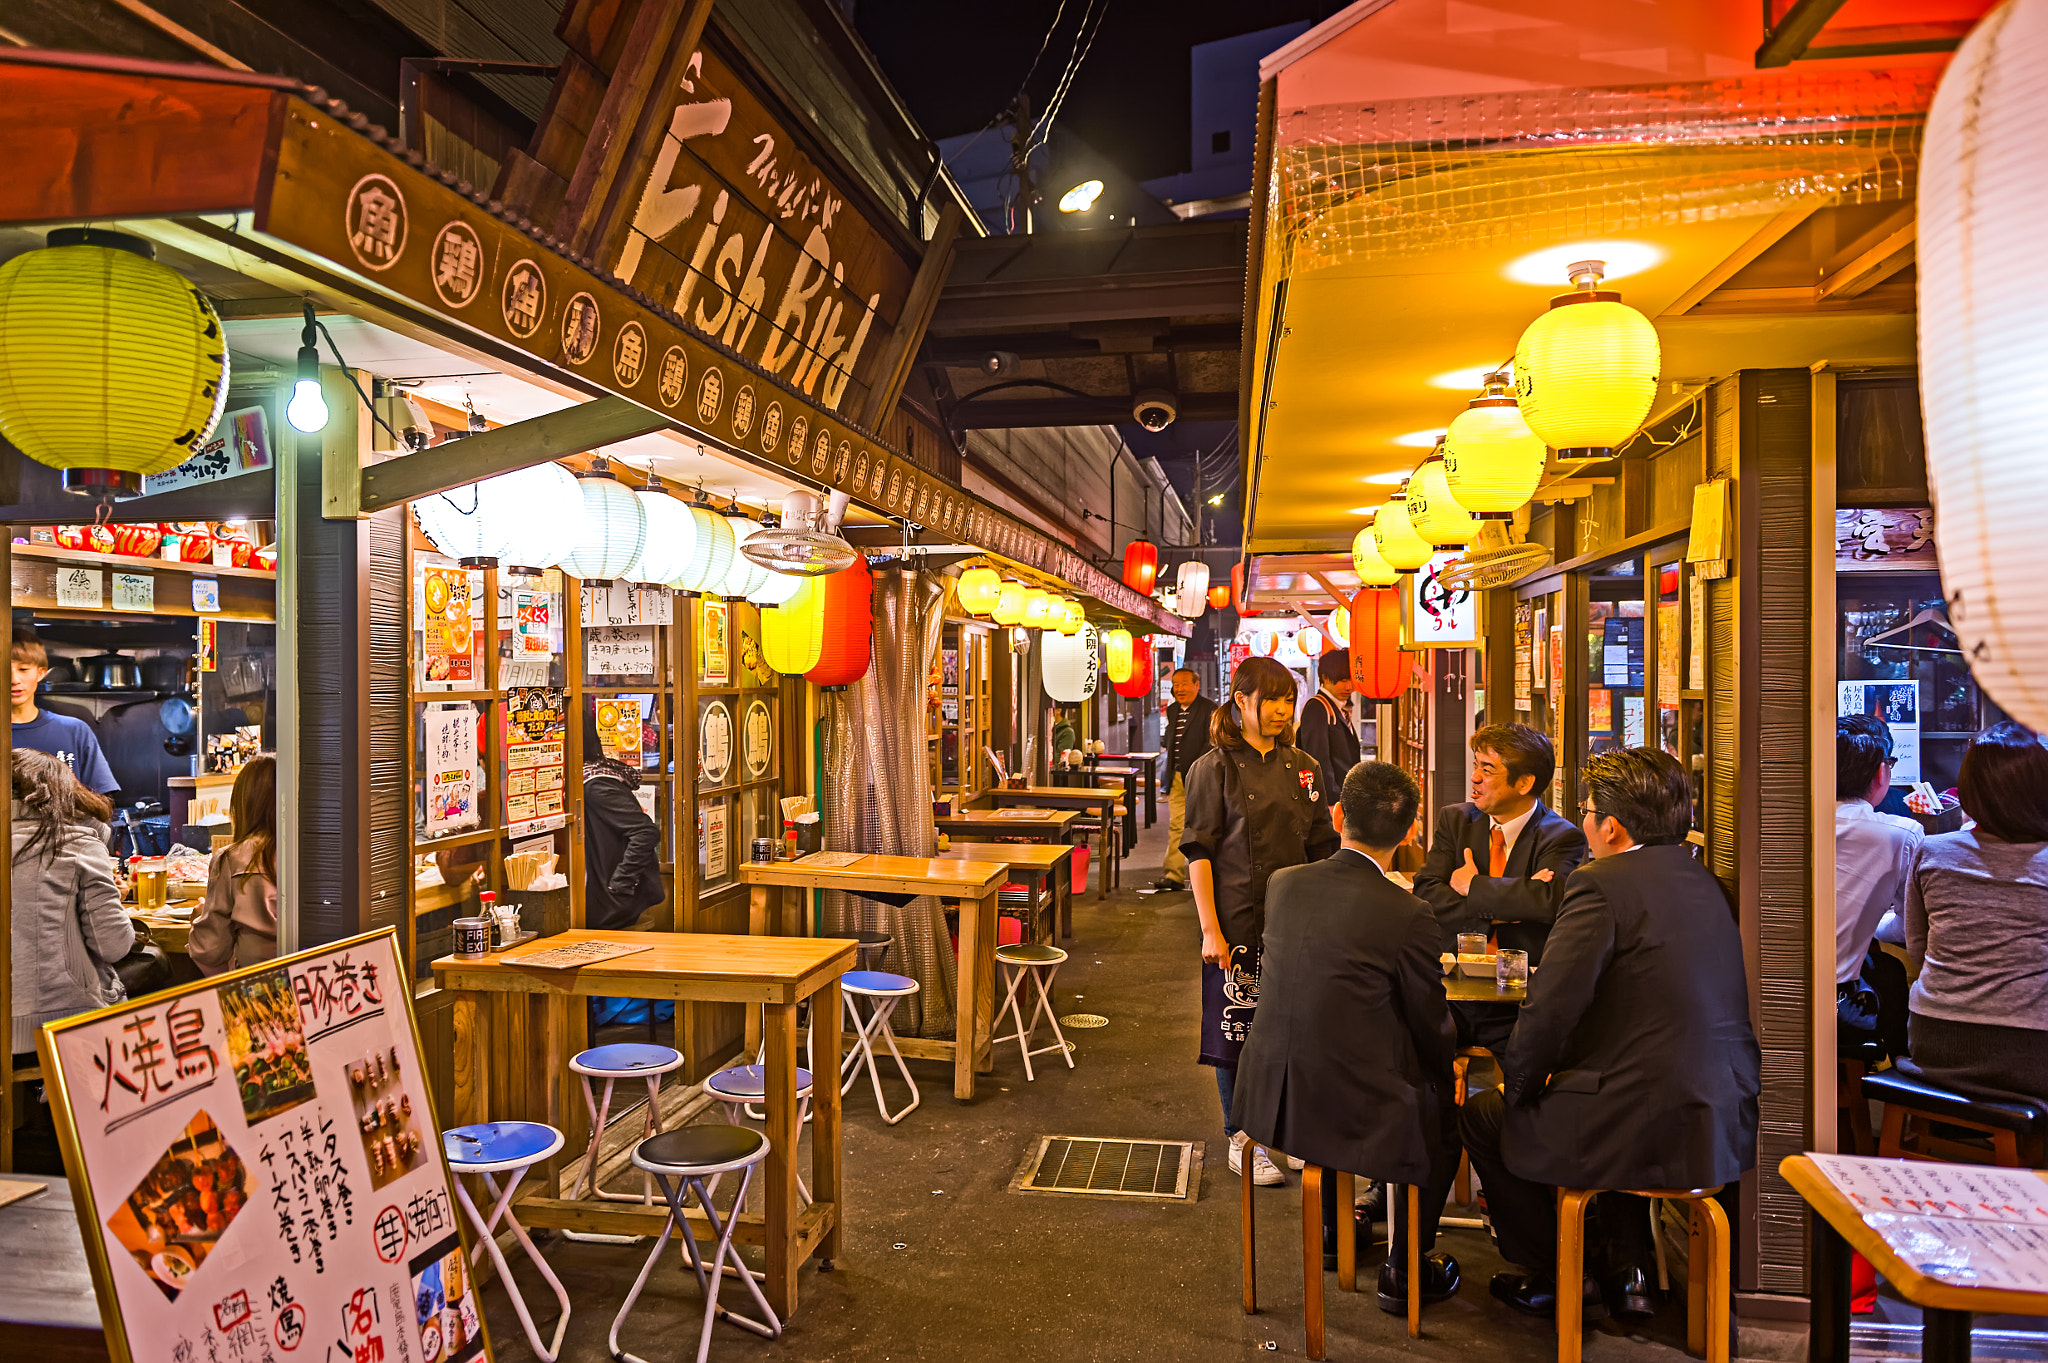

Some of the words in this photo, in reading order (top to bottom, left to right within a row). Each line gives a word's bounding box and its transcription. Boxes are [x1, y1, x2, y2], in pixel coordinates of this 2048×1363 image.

[613, 97, 774, 357] Fish
[518, 606, 548, 625] とくとく
[608, 616, 623, 626] 500
[589, 627, 640, 643] 歳の数だけ
[525, 636, 549, 652] 取扱店
[756, 845, 770, 853] FIRE
[756, 853, 770, 861] EXIT
[466, 929, 489, 941] FIRE
[466, 941, 489, 953] EXIT
[292, 952, 383, 1026] 豚巻き
[1221, 1020, 1253, 1033] 白金
[1224, 1031, 1246, 1042] 電話
[93, 1000, 219, 1113] 焼鳥
[318, 1115, 353, 1226] レタス巻き
[300, 1120, 337, 1240] 半熟卵巻き
[260, 1143, 301, 1264] チーズ巻き
[374, 1186, 453, 1259] 芋焼酎
